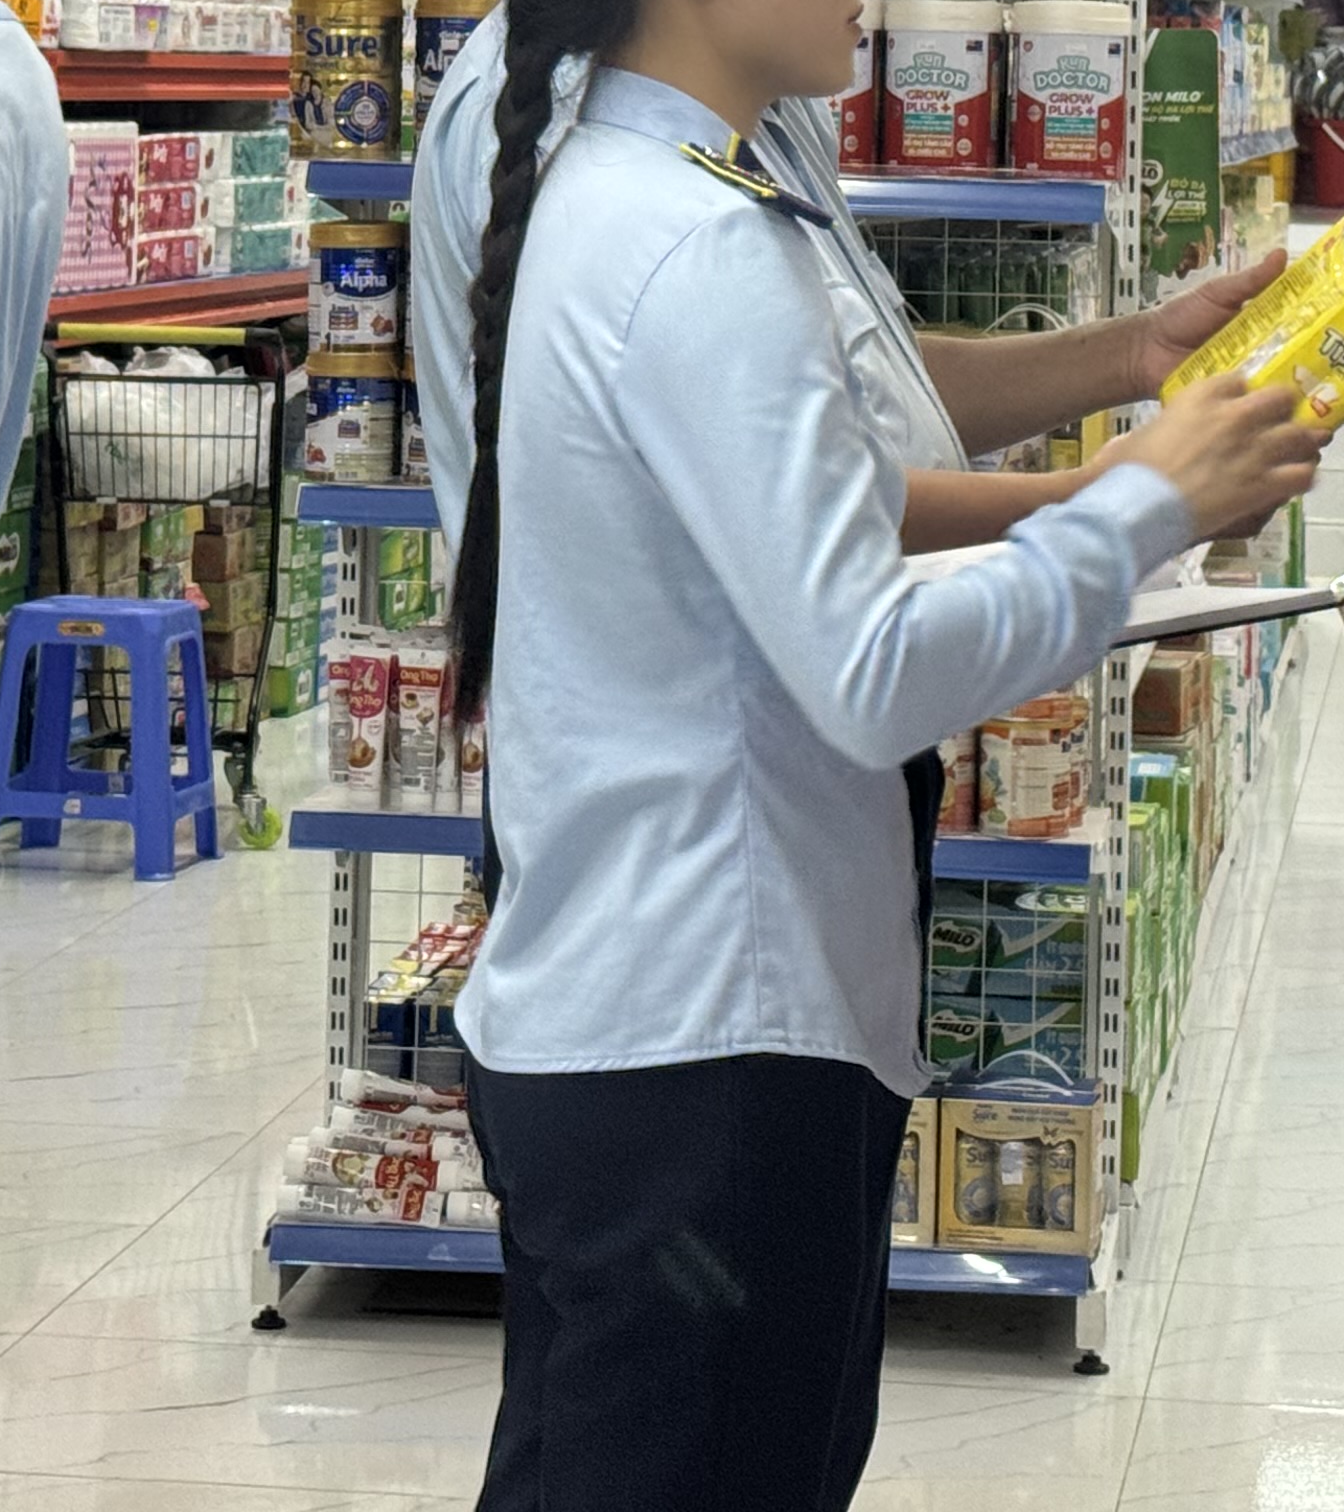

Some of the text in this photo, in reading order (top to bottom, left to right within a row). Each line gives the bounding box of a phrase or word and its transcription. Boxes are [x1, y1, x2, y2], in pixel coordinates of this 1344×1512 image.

[305, 26, 379, 58] Sure
[913, 53, 945, 69] Kun
[1057, 56, 1090, 71] Kun
[895, 68, 970, 90] DOCTOR
[1034, 71, 1110, 93] DOCTOR
[905, 90, 951, 101] GROW
[1048, 92, 1095, 104] GROW
[1165, 91, 1202, 103] MILO
[906, 102, 940, 113] PLUS
[1048, 105, 1083, 116] PLUS
[340, 269, 387, 291] Alpha
